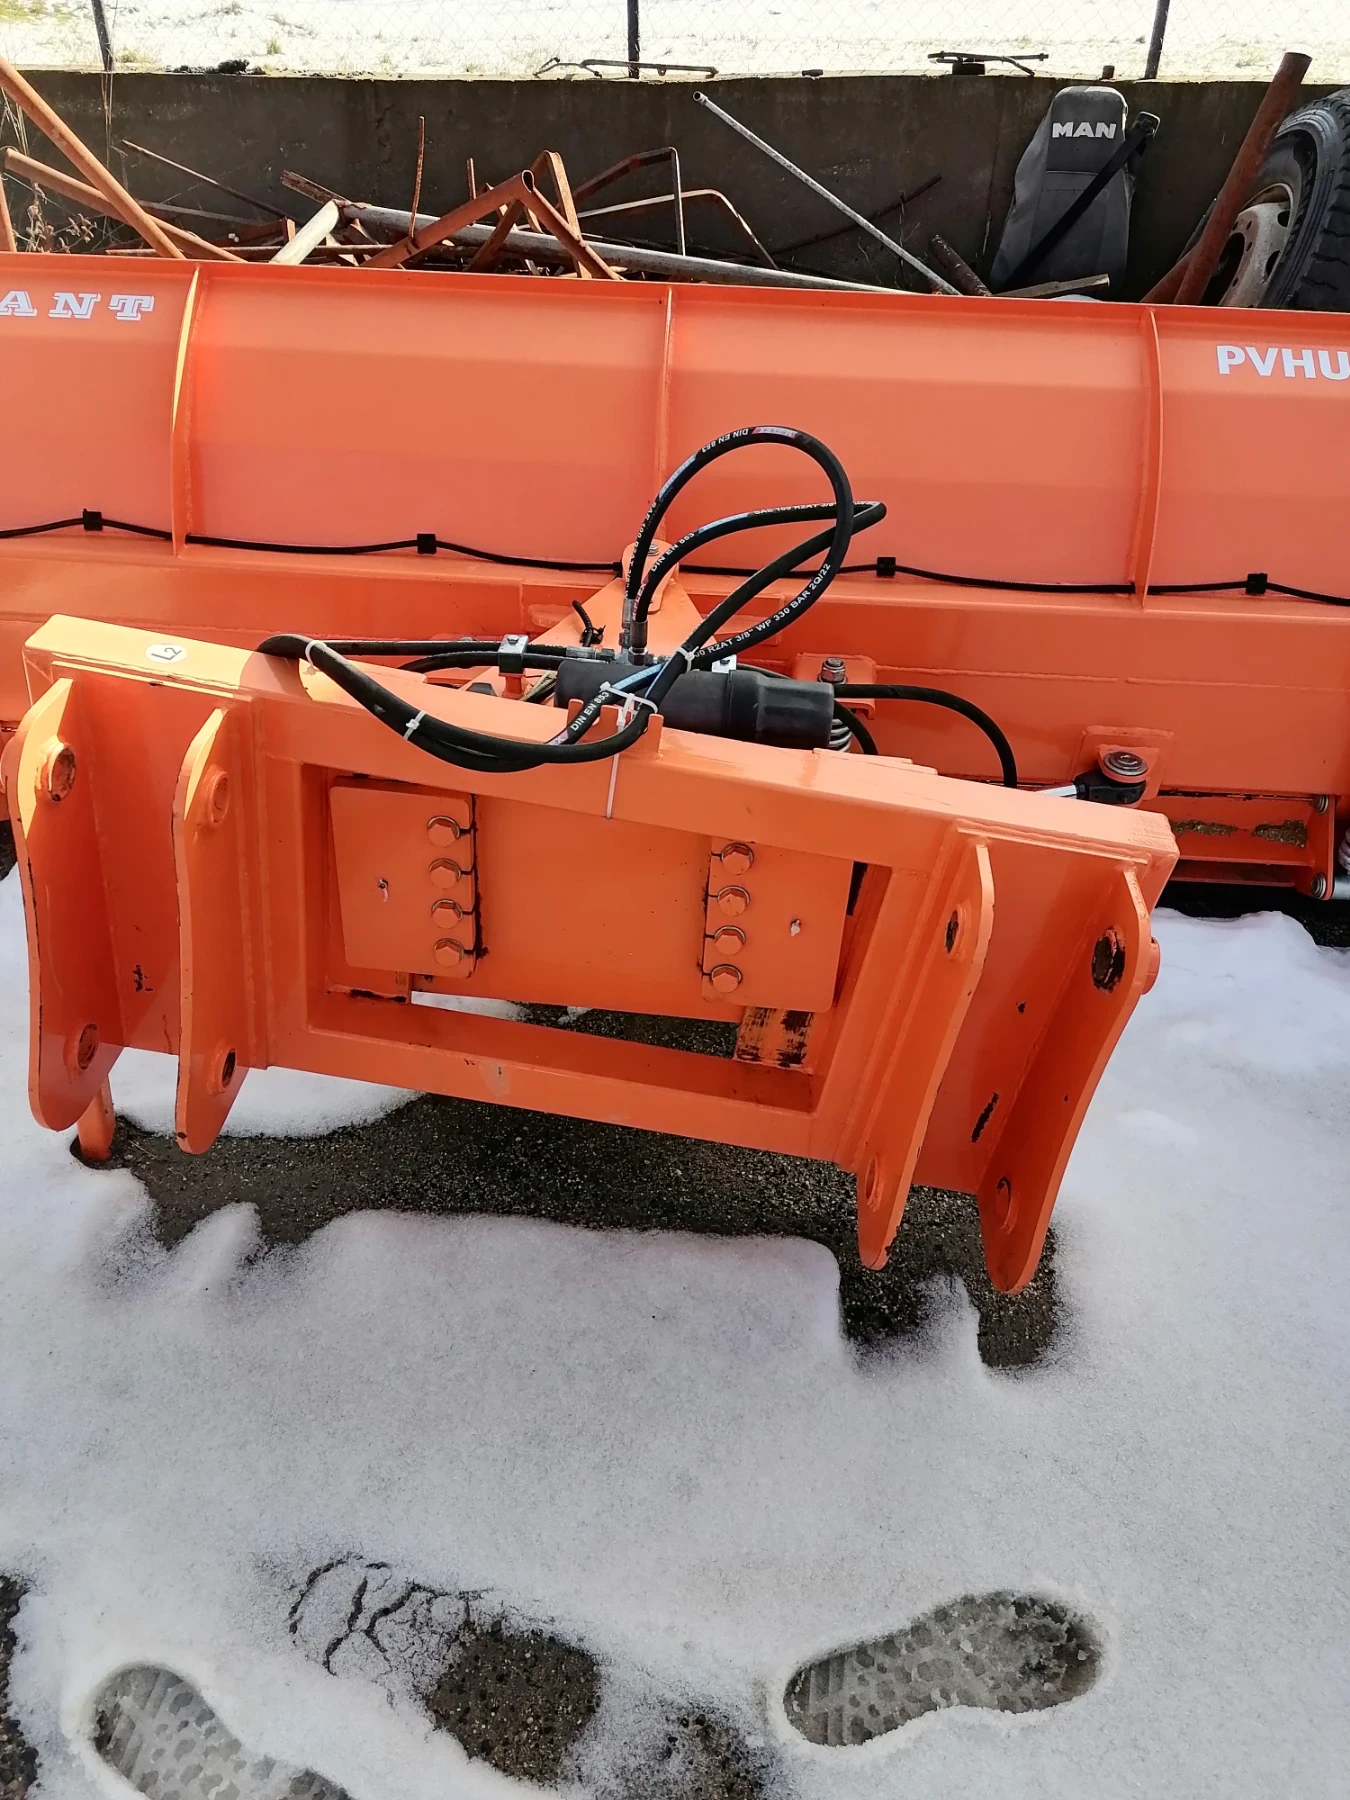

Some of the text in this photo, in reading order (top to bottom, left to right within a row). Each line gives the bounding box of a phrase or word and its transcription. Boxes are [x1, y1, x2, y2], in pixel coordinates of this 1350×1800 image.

[1052, 122, 1117, 139] MAN
[1216, 345, 1350, 380] PVHU
[718, 433, 731, 444] EN
[733, 428, 749, 438] DIN
[651, 555, 666, 572] DIN
[665, 544, 679, 556] EN
[707, 639, 733, 654] R2AT
[736, 628, 754, 642] 3/8"
[755, 619, 772, 632] WP
[773, 608, 790, 622] 330
[790, 590, 811, 609] BAR
[808, 563, 831, 591] 2Q/22
[570, 715, 587, 731] DIN
[584, 703, 597, 715] EN
[594, 692, 609, 704] 853
